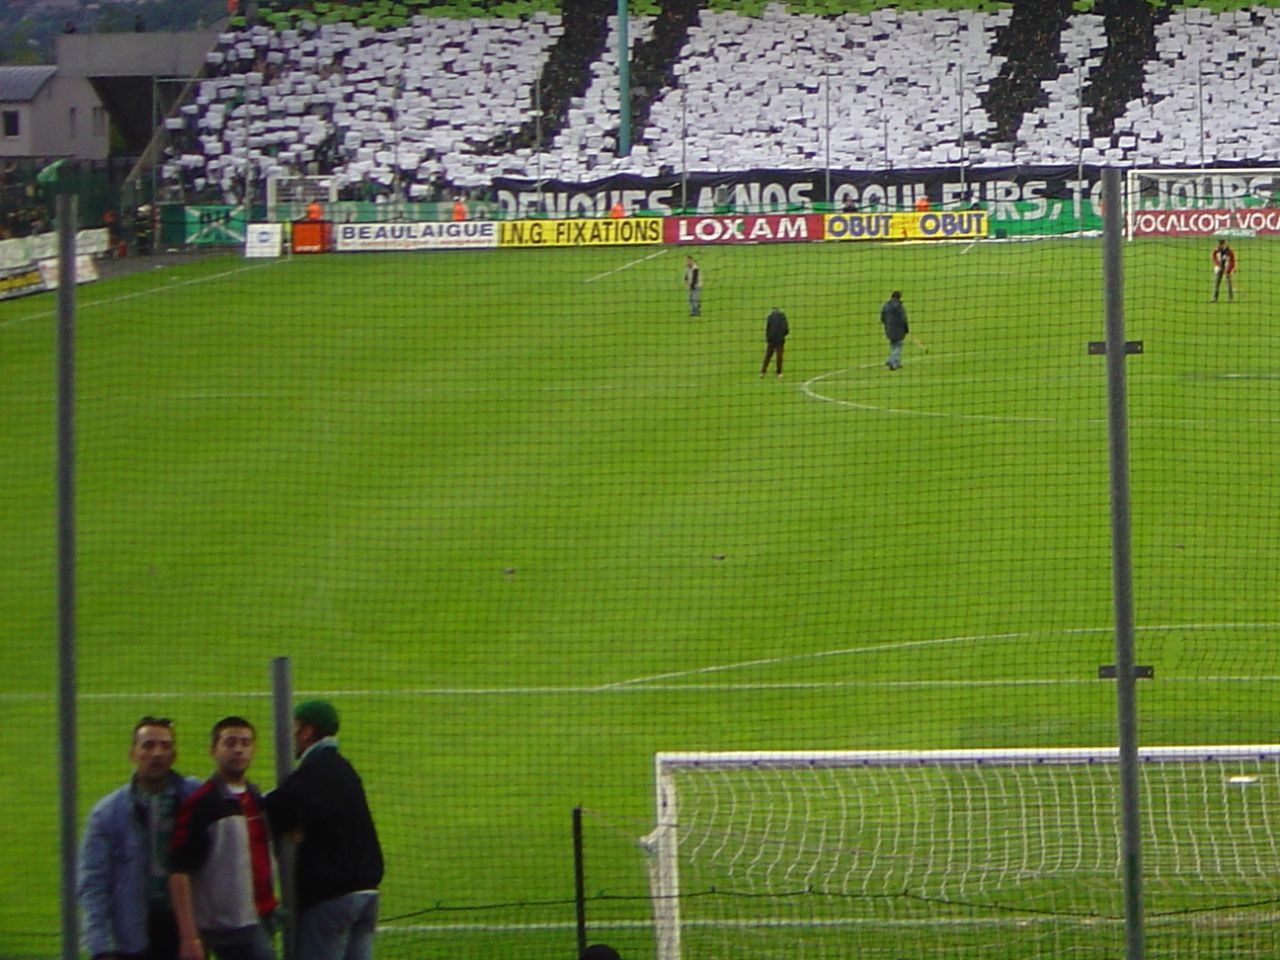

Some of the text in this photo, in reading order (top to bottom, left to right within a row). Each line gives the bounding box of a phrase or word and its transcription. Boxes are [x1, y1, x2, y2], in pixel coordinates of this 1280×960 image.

[736, 182, 813, 214] NOS
[342, 223, 494, 239] BEAULAIGUE
[556, 219, 660, 244] FIXATIONS
[679, 217, 808, 240] LOXAM
[828, 213, 984, 237] OBUT OBUT
